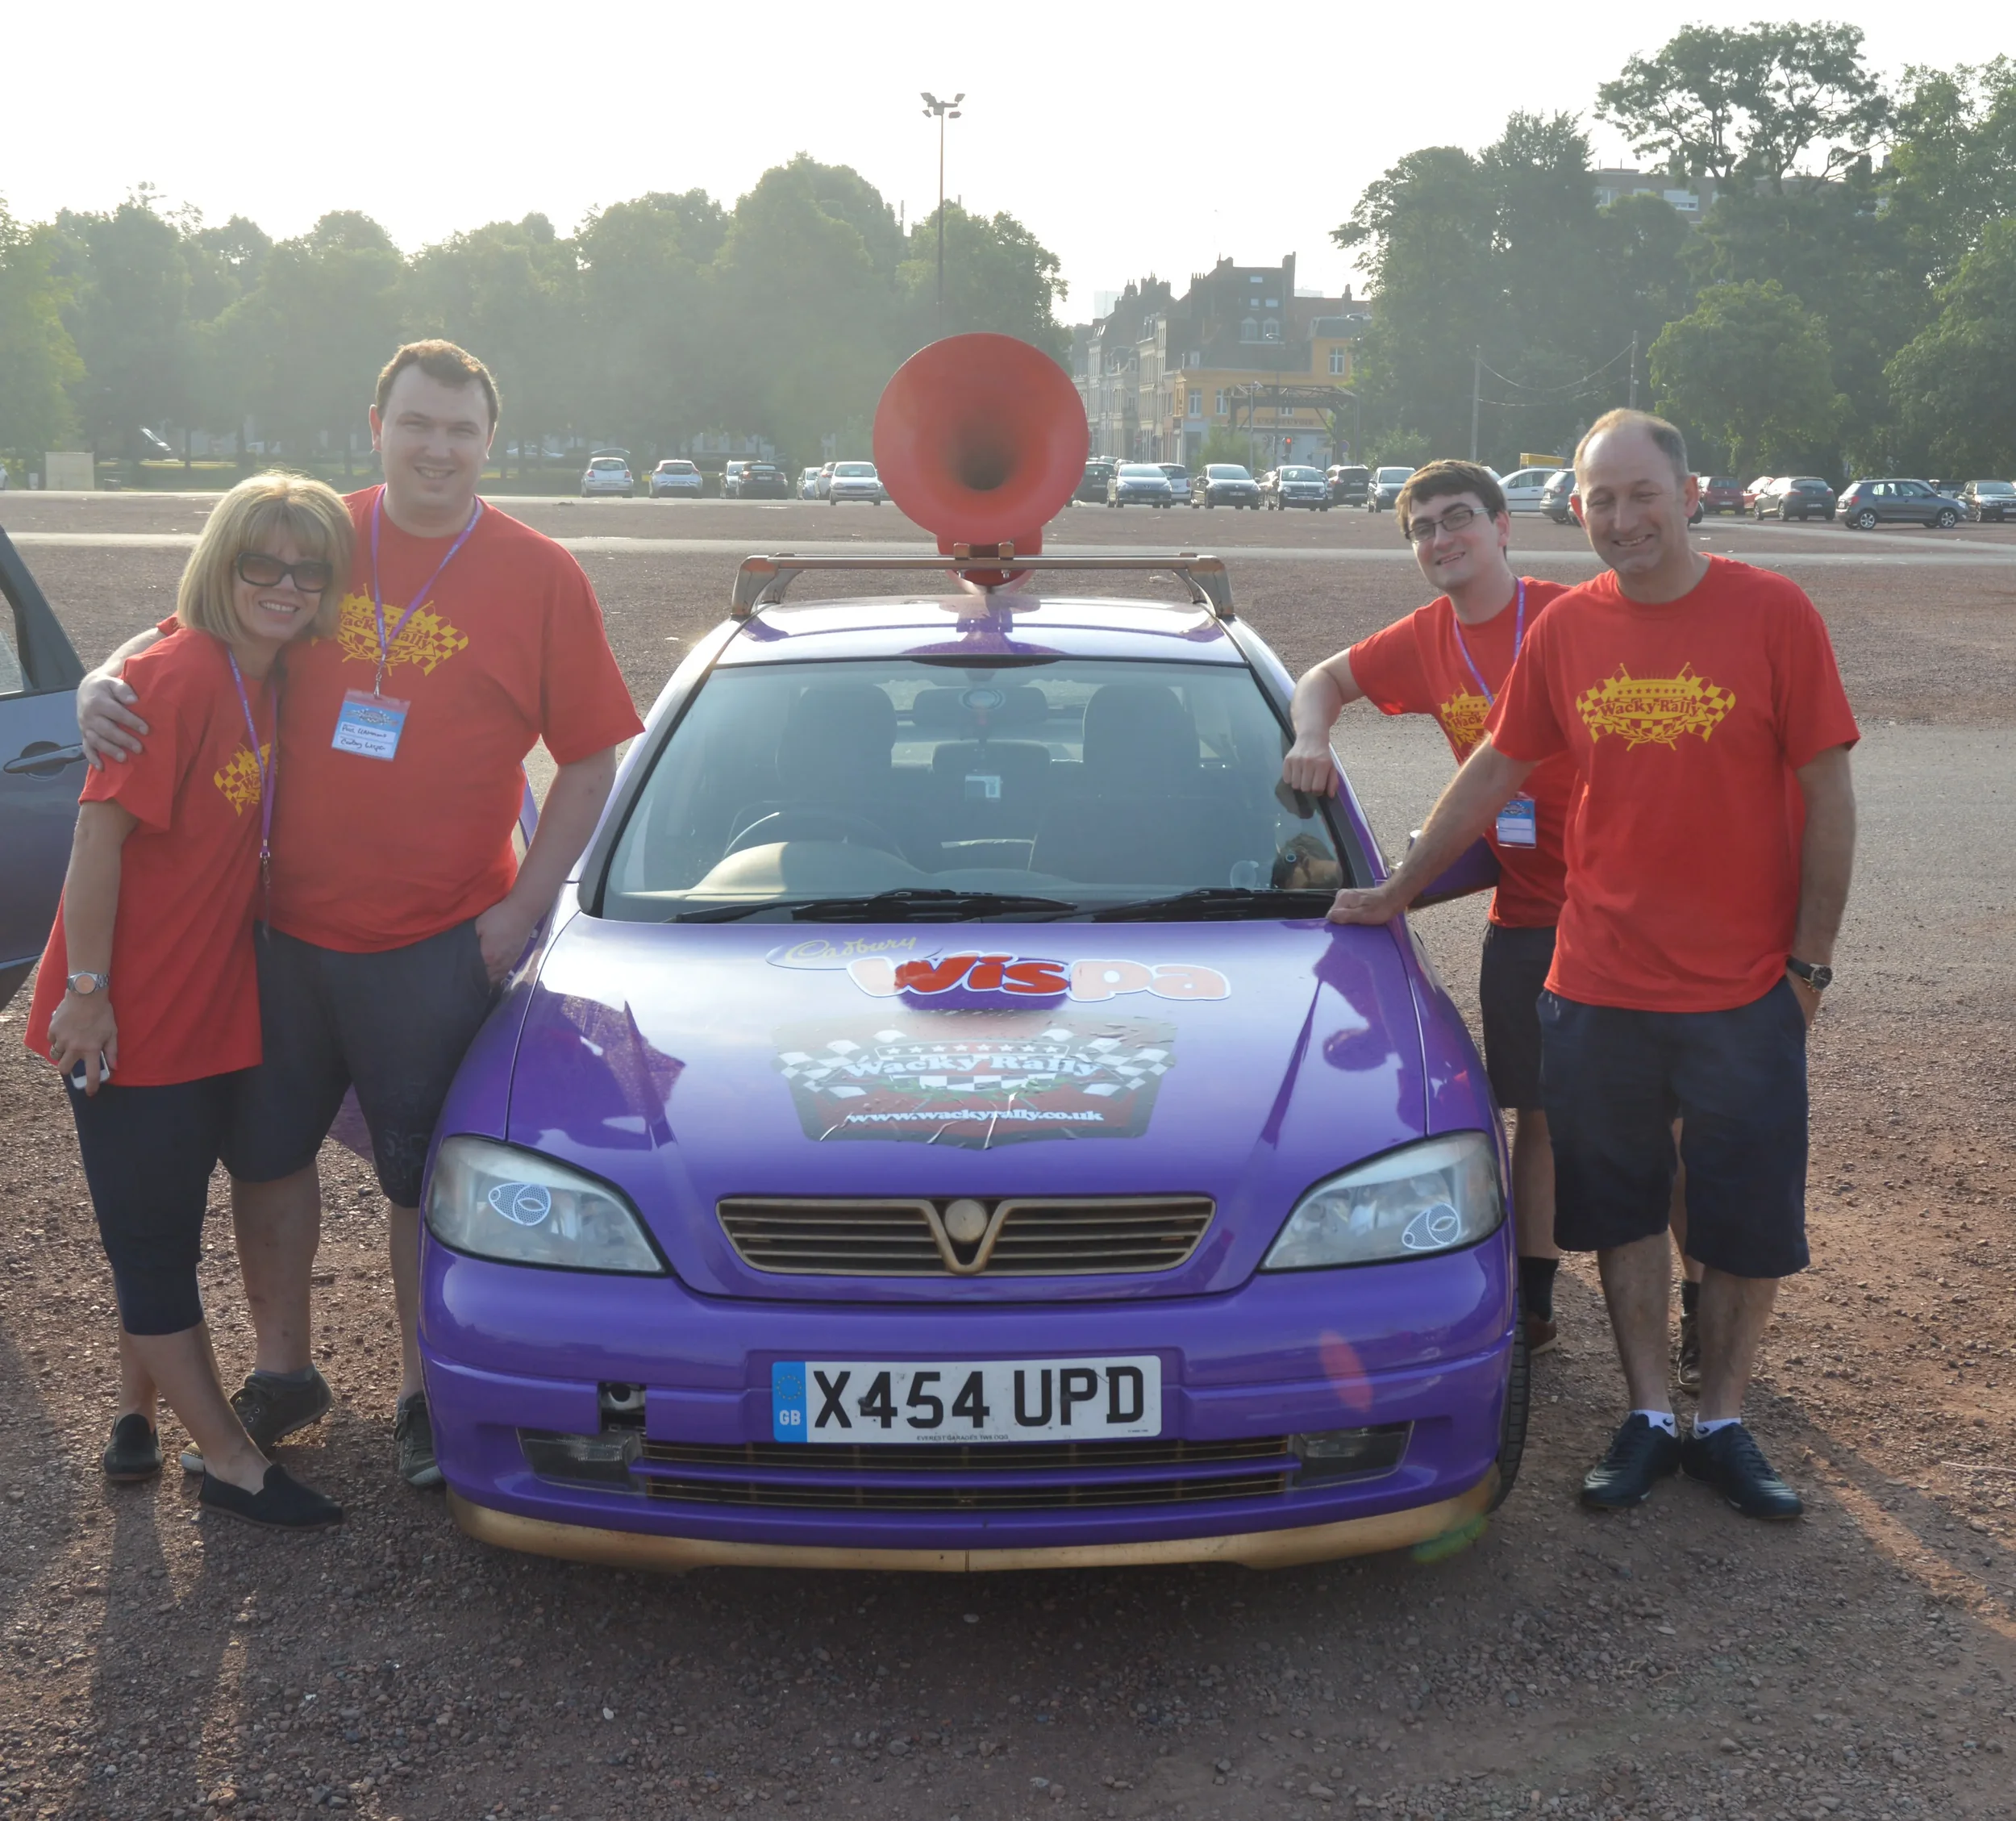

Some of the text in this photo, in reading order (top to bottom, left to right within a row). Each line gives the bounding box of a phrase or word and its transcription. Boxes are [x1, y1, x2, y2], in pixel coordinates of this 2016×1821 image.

[339, 614, 382, 635] ack
[1600, 698, 1700, 717] Wacky Rally
[1452, 711, 1484, 727] Wack
[784, 936, 917, 964] Cadbury
[844, 1054, 1102, 1077] Wacky Rally
[847, 1108, 1104, 1123] www.wackyrally.co.uk
[813, 1365, 1144, 1429] X454 UPD
[779, 1409, 802, 1426] GB
